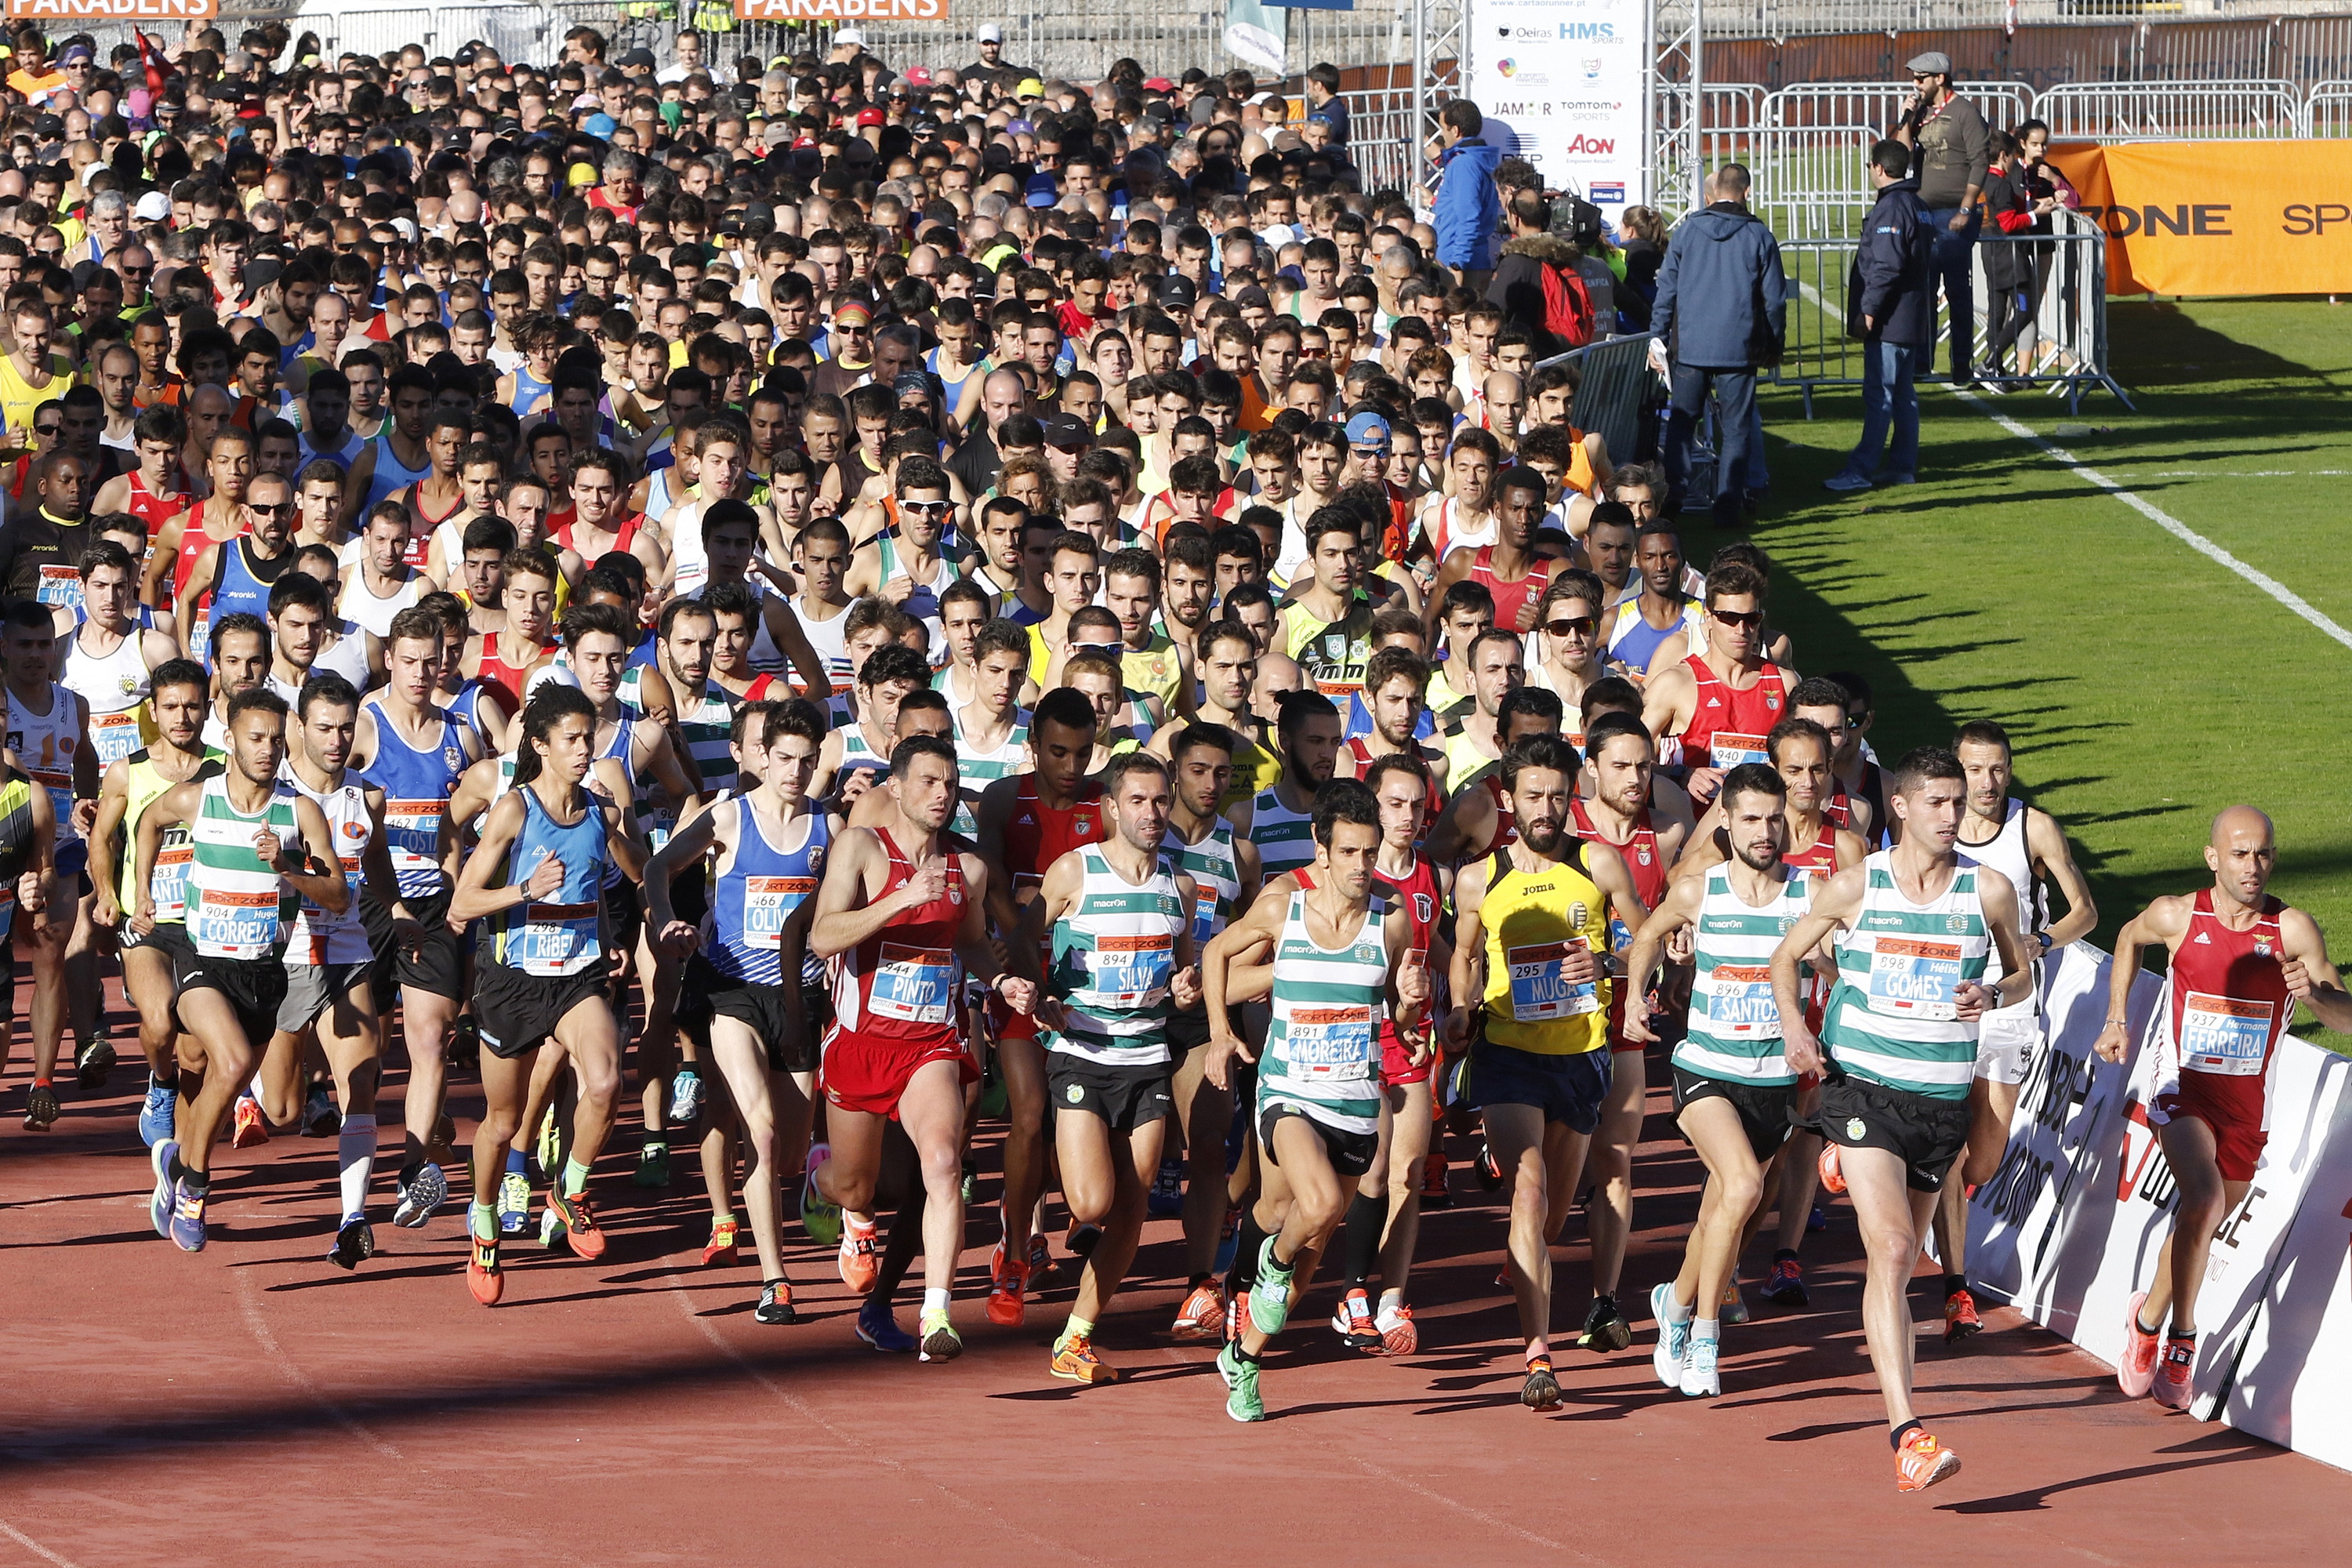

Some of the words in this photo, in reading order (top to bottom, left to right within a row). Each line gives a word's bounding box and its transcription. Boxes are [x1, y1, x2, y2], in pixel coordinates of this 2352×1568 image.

[1516, 27, 1552, 38] Oeiras
[1559, 23, 1613, 39] HMS
[2282, 204, 2352, 235] SP
[114, 728, 137, 738] Filipe
[1718, 750, 1739, 761] 940
[390, 818, 411, 829] 462
[157, 854, 179, 863] ORT
[1523, 883, 1555, 896] Joma
[203, 893, 238, 902] SPORT
[240, 895, 278, 905] ZONE
[753, 895, 775, 906] 466
[1093, 898, 1127, 908] macron
[206, 907, 229, 918] 904
[254, 909, 277, 920] Hugo
[575, 920, 596, 931] Miguel
[1708, 920, 1743, 929] macron
[1868, 916, 1903, 926] macron
[207, 920, 269, 943] CORREIA
[533, 922, 556, 933] 298
[536, 934, 587, 958] RIBEIRO
[1284, 946, 1319, 955] macron
[1876, 942, 1917, 953] SPORT
[1103, 954, 1127, 965] 894
[1880, 956, 1905, 970] 898
[1930, 962, 1959, 975] Hélio
[885, 963, 911, 975] 944
[1515, 965, 1539, 978] 295
[1118, 966, 1153, 991] SILVA
[891, 976, 936, 1004] PINTO
[1531, 976, 1578, 1001] MUGA
[1716, 984, 1740, 996] 896
[1886, 972, 1943, 1001] GOMES
[2189, 999, 2228, 1011] SPORT
[2230, 1005, 2270, 1015] ZONE
[2192, 1013, 2217, 1026] 937
[2227, 1019, 2269, 1031] Hermano
[1294, 1026, 1318, 1037] 891
[1347, 1025, 1370, 1036] José
[2187, 1027, 2261, 1057] FERREIRA
[1296, 1038, 1363, 1063] MOREIRA
